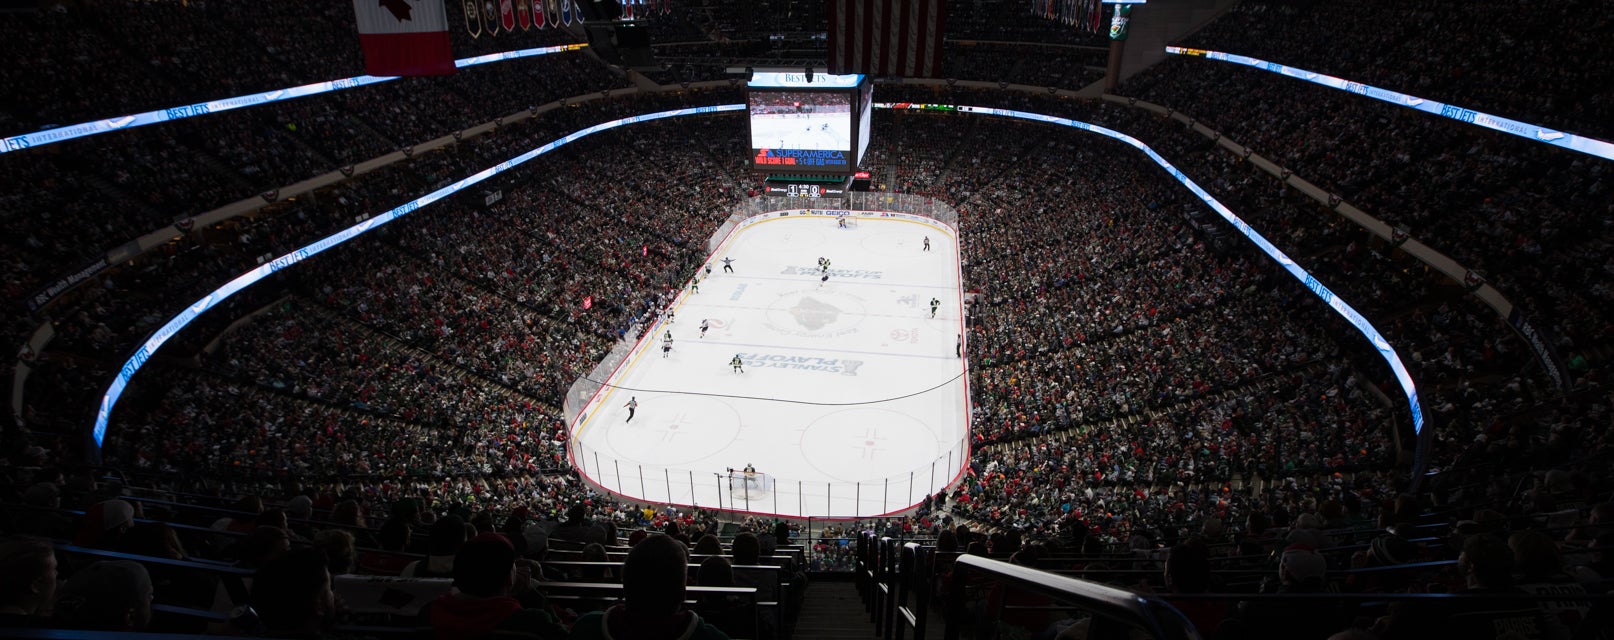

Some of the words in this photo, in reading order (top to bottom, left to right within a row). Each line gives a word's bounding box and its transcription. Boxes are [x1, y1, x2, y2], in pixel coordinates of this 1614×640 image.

[785, 74, 804, 82] BEST
[167, 107, 190, 119] BEST
[190, 104, 210, 116] JETS
[1441, 104, 1461, 120] BEST
[1460, 108, 1477, 123] JETS
[1478, 116, 1527, 134] INTERNATIONAL
[3, 136, 30, 151] JETS
[776, 150, 844, 158] SUPERAMERICA
[269, 255, 291, 272] BEST
[290, 248, 309, 262] JETS
[1305, 274, 1321, 296] BEST
